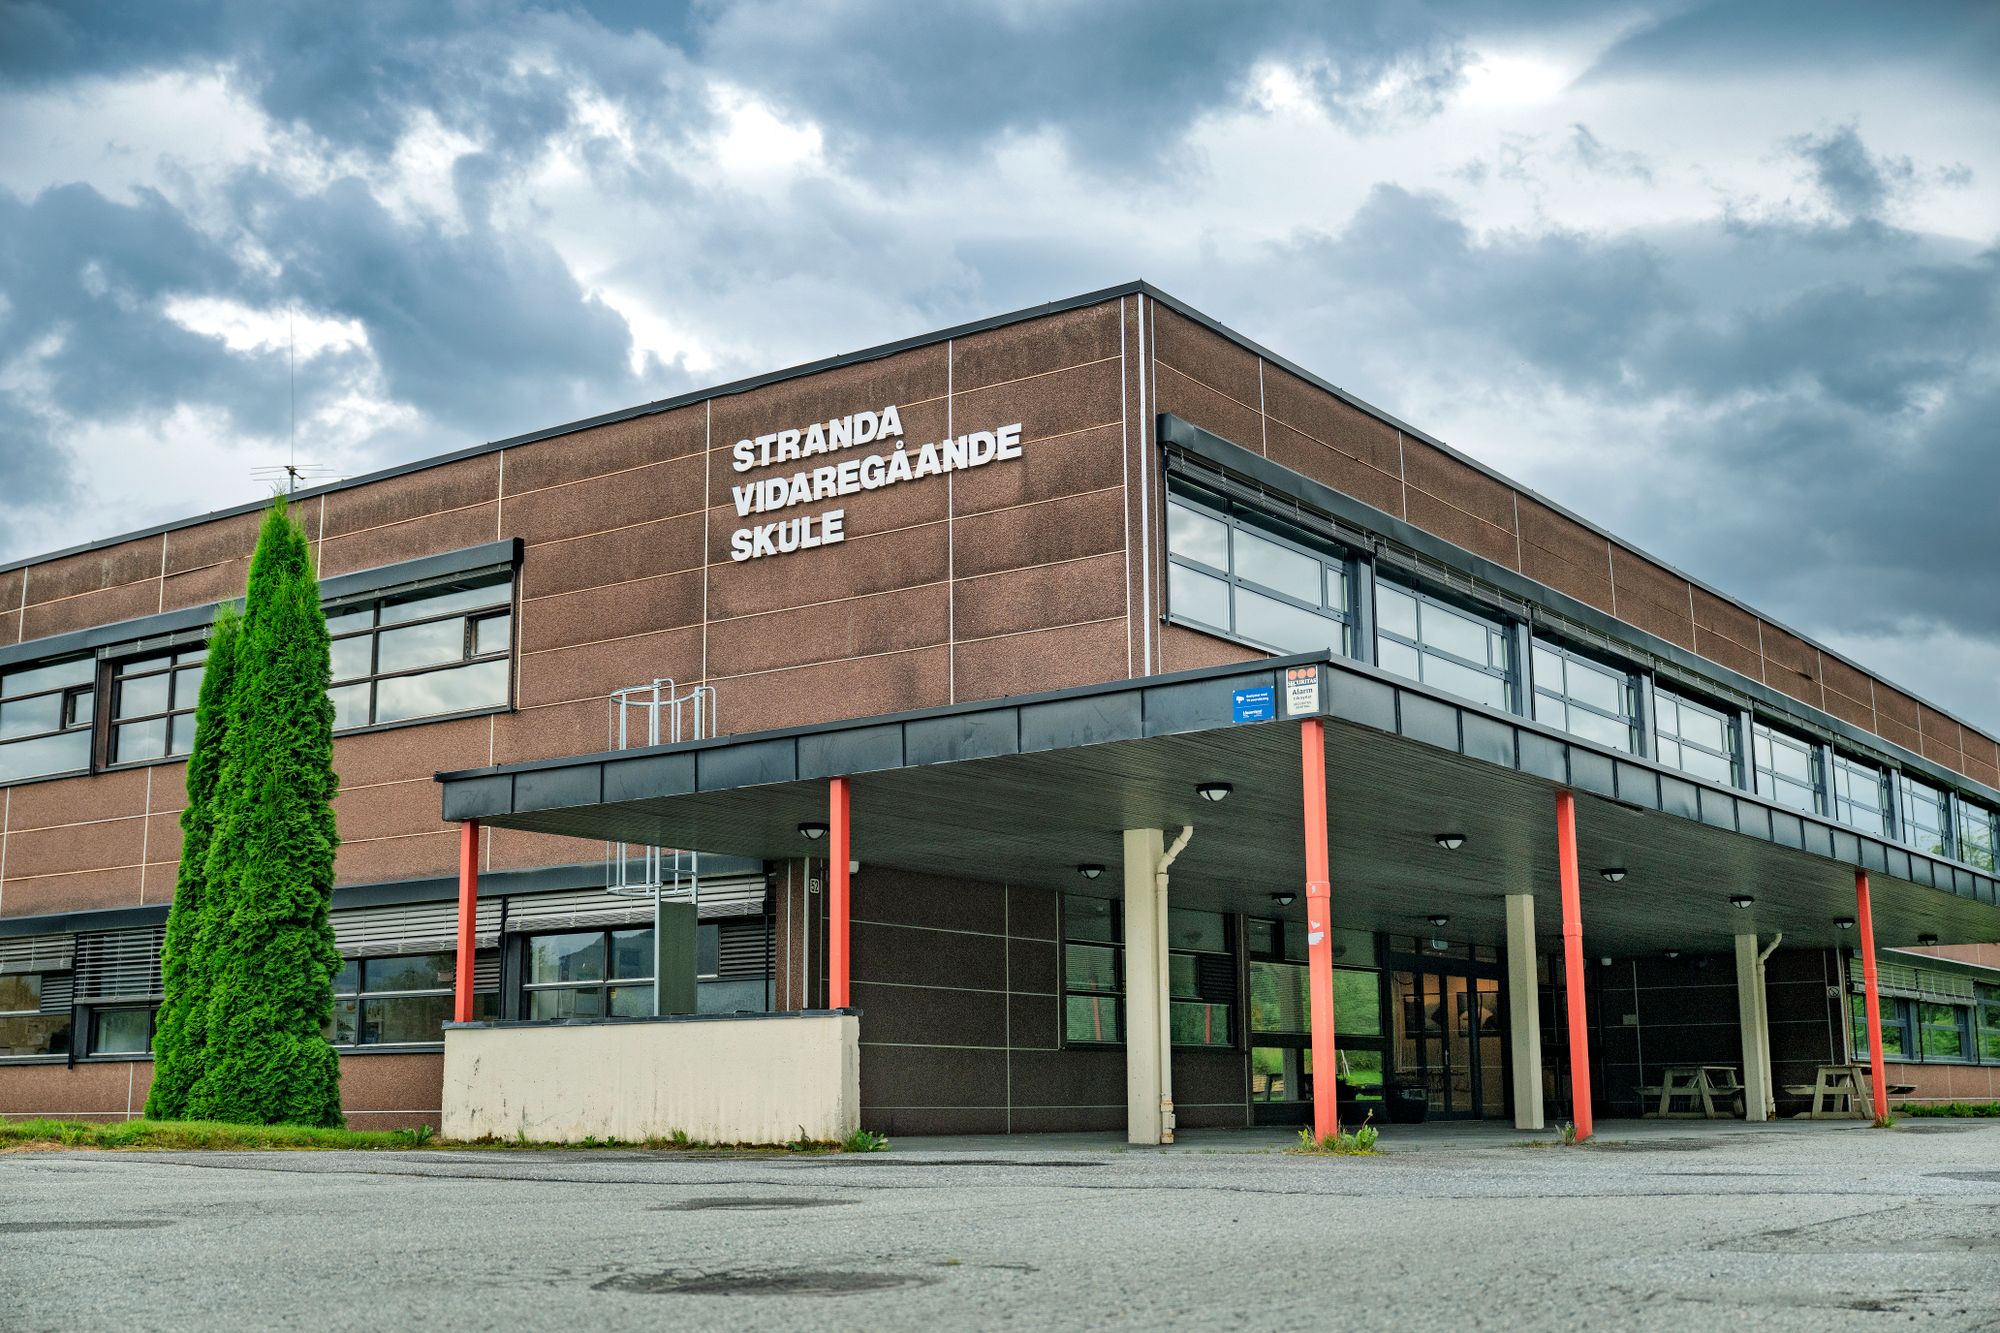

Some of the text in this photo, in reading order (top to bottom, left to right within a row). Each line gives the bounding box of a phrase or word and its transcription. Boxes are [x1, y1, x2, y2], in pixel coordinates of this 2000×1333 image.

[732, 405, 904, 473] STRANDA
[732, 423, 1022, 517] VIDAREGÅANDE
[730, 509, 845, 562] SKULE
[1288, 677, 1316, 687] SECURITAS
[1292, 688, 1312, 696] Alarm
[811, 880, 819, 892] 52
